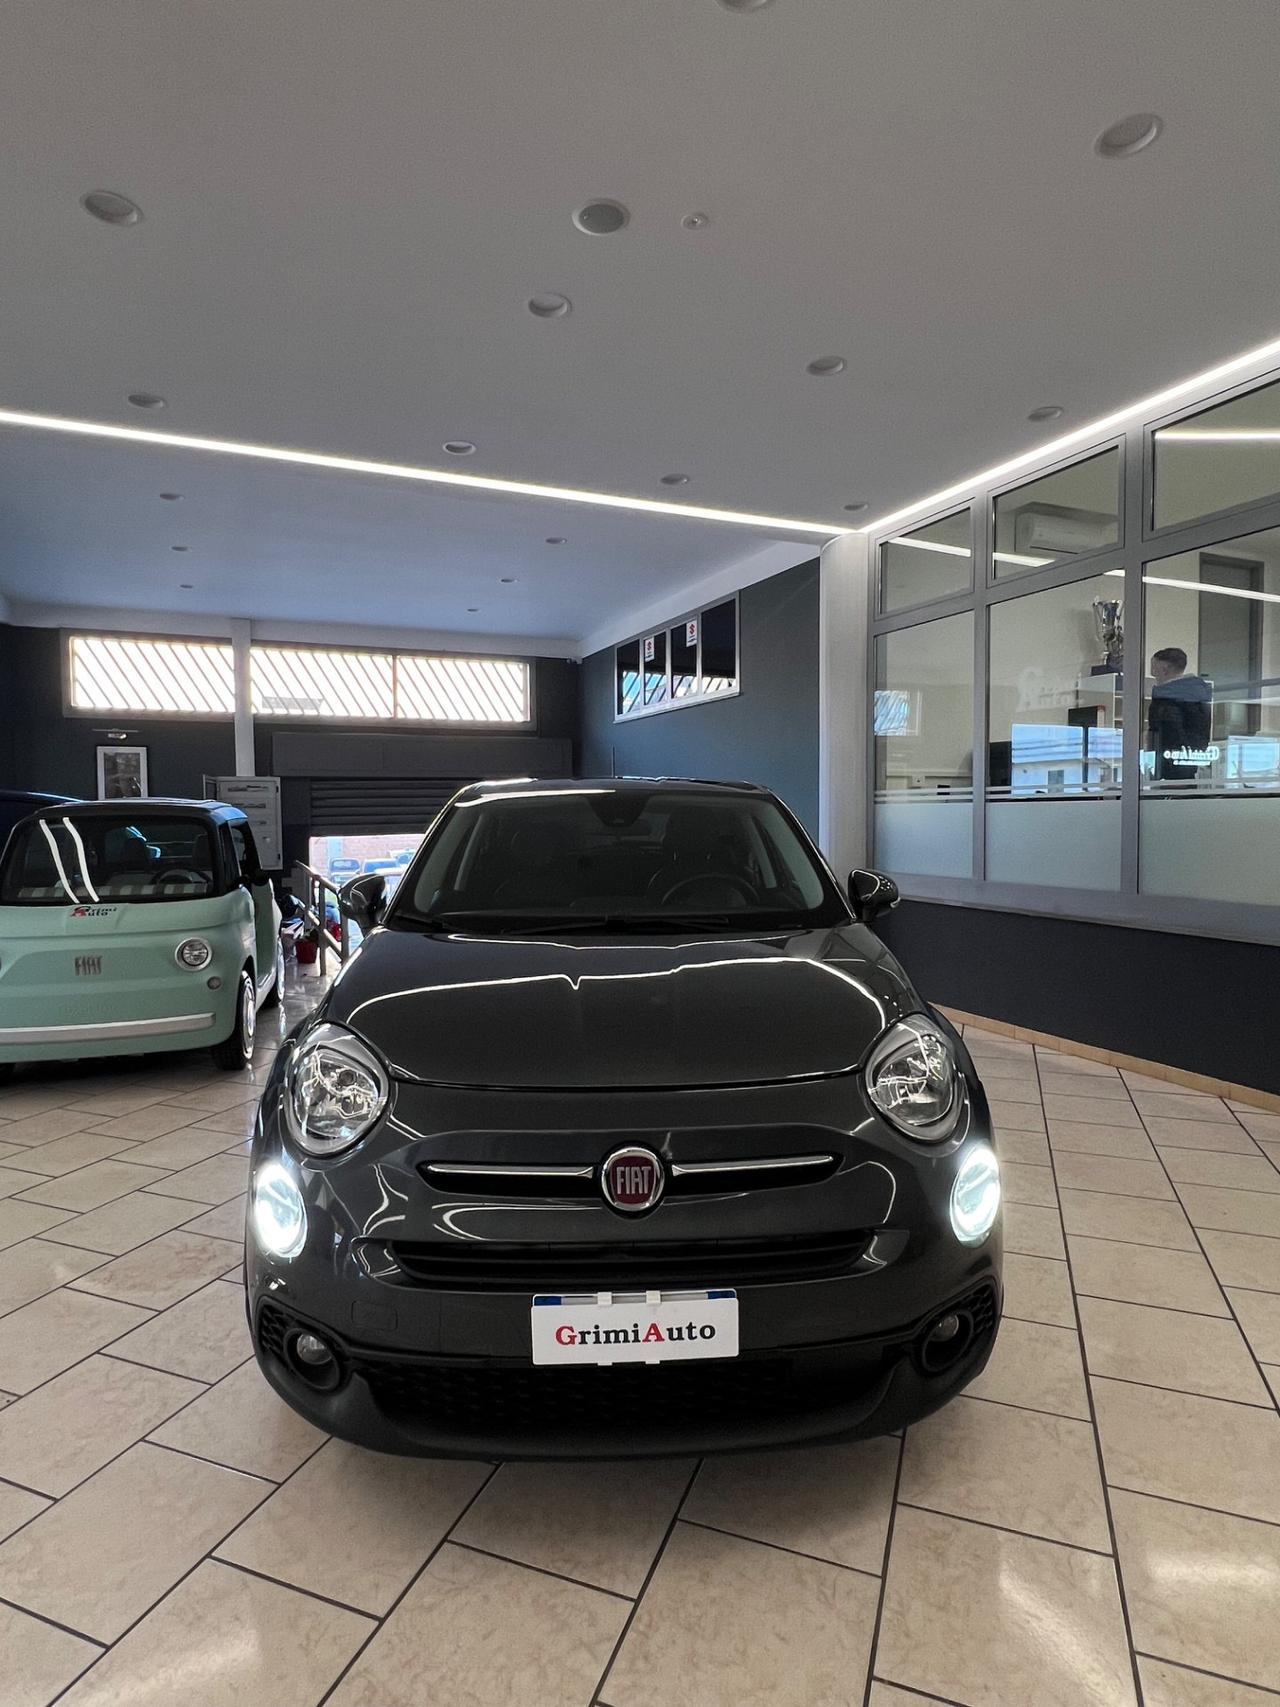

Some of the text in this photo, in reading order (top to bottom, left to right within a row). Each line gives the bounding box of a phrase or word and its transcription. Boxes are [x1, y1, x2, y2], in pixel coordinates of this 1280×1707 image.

[74, 954, 103, 976] FIAT
[616, 1166, 651, 1195] FIAT
[555, 1321, 716, 1346] GrimiAuto
